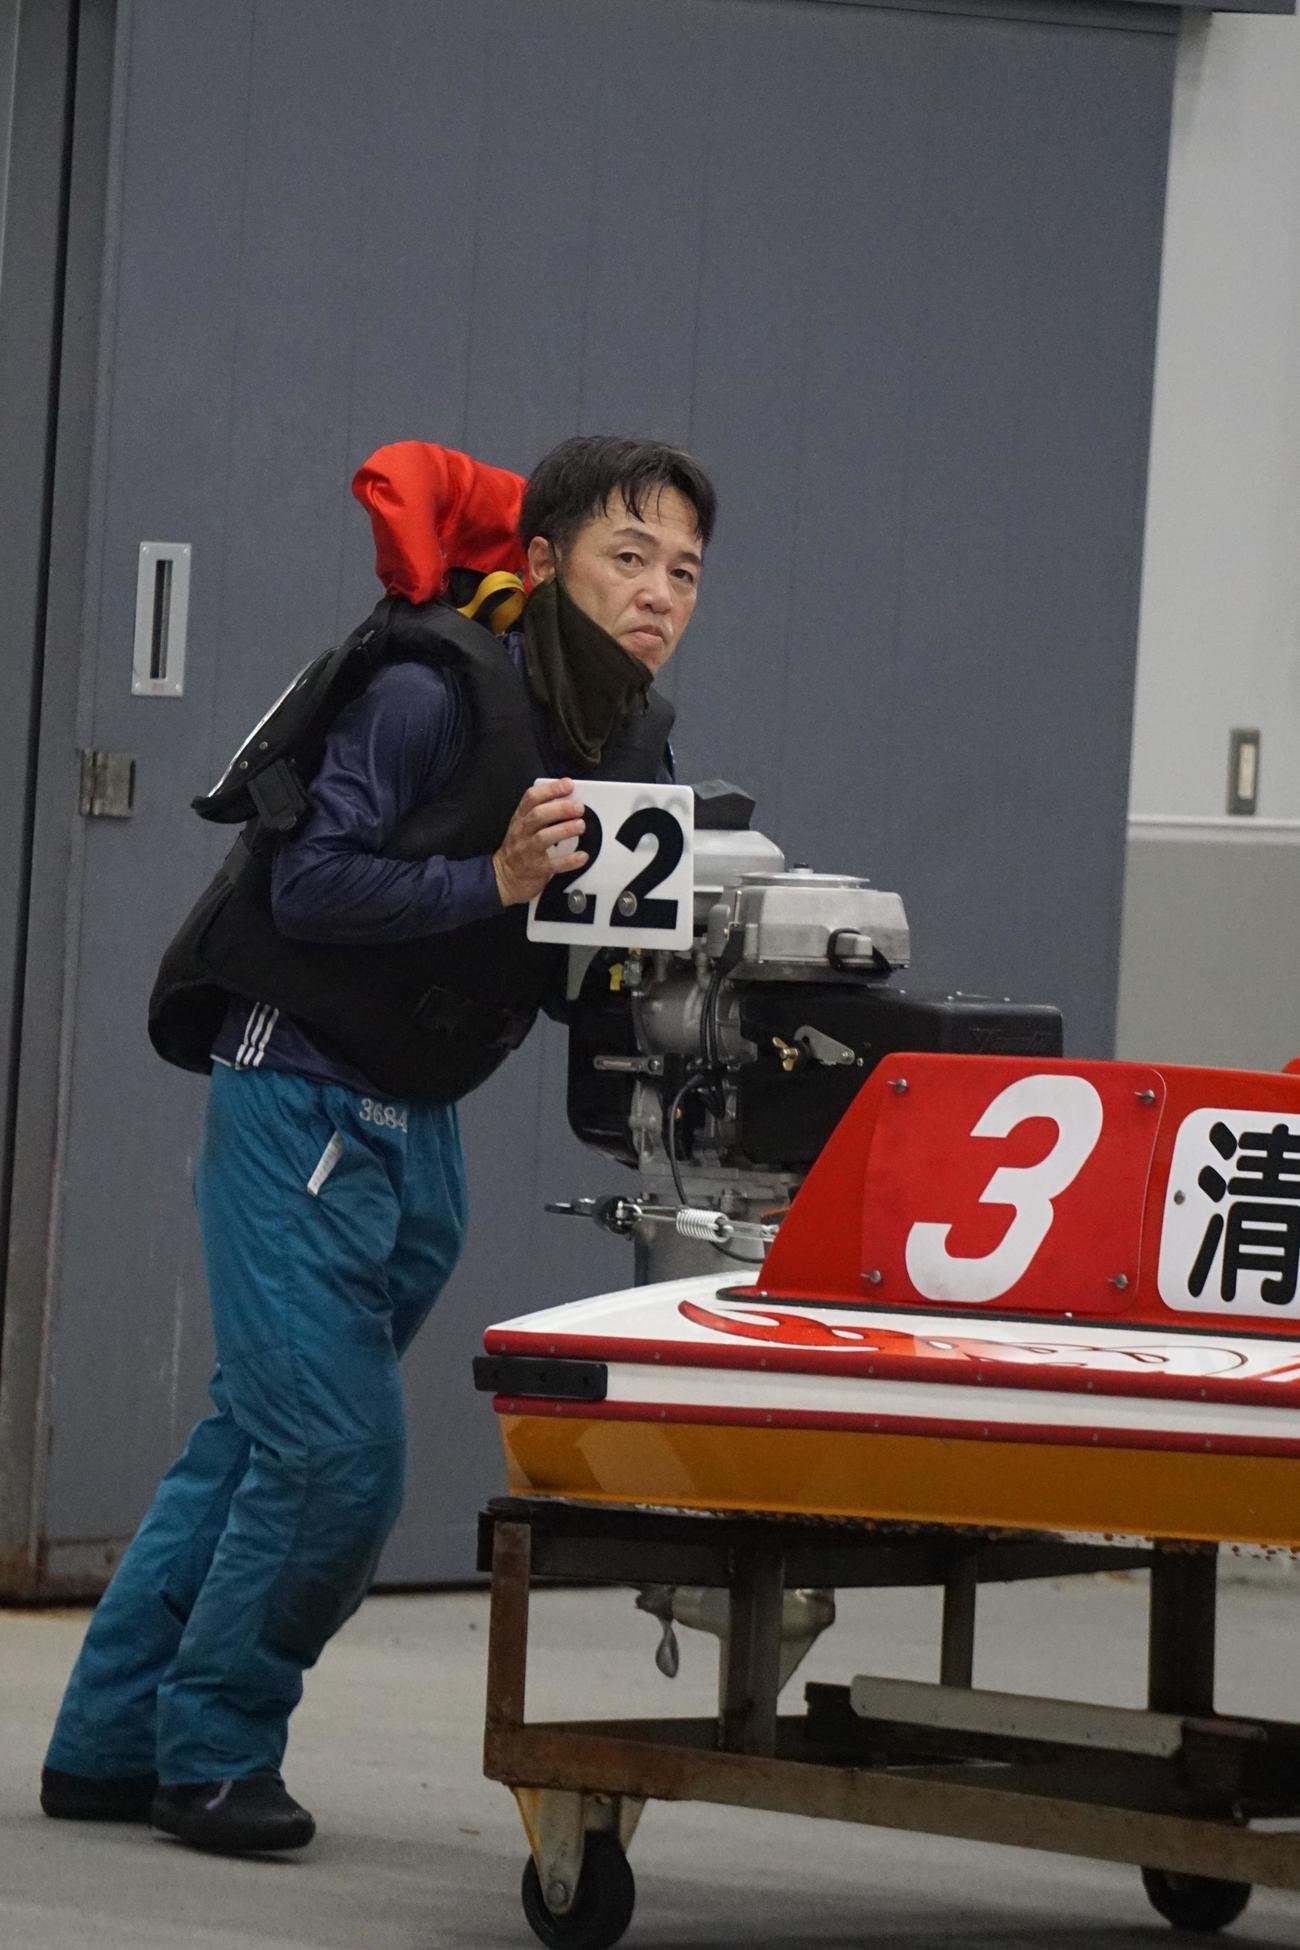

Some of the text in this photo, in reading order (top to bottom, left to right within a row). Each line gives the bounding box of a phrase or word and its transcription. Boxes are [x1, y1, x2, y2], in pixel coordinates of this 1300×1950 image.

[534, 804, 684, 930] 22
[359, 1098, 408, 1134] 3684
[905, 1074, 1104, 1302] 3
